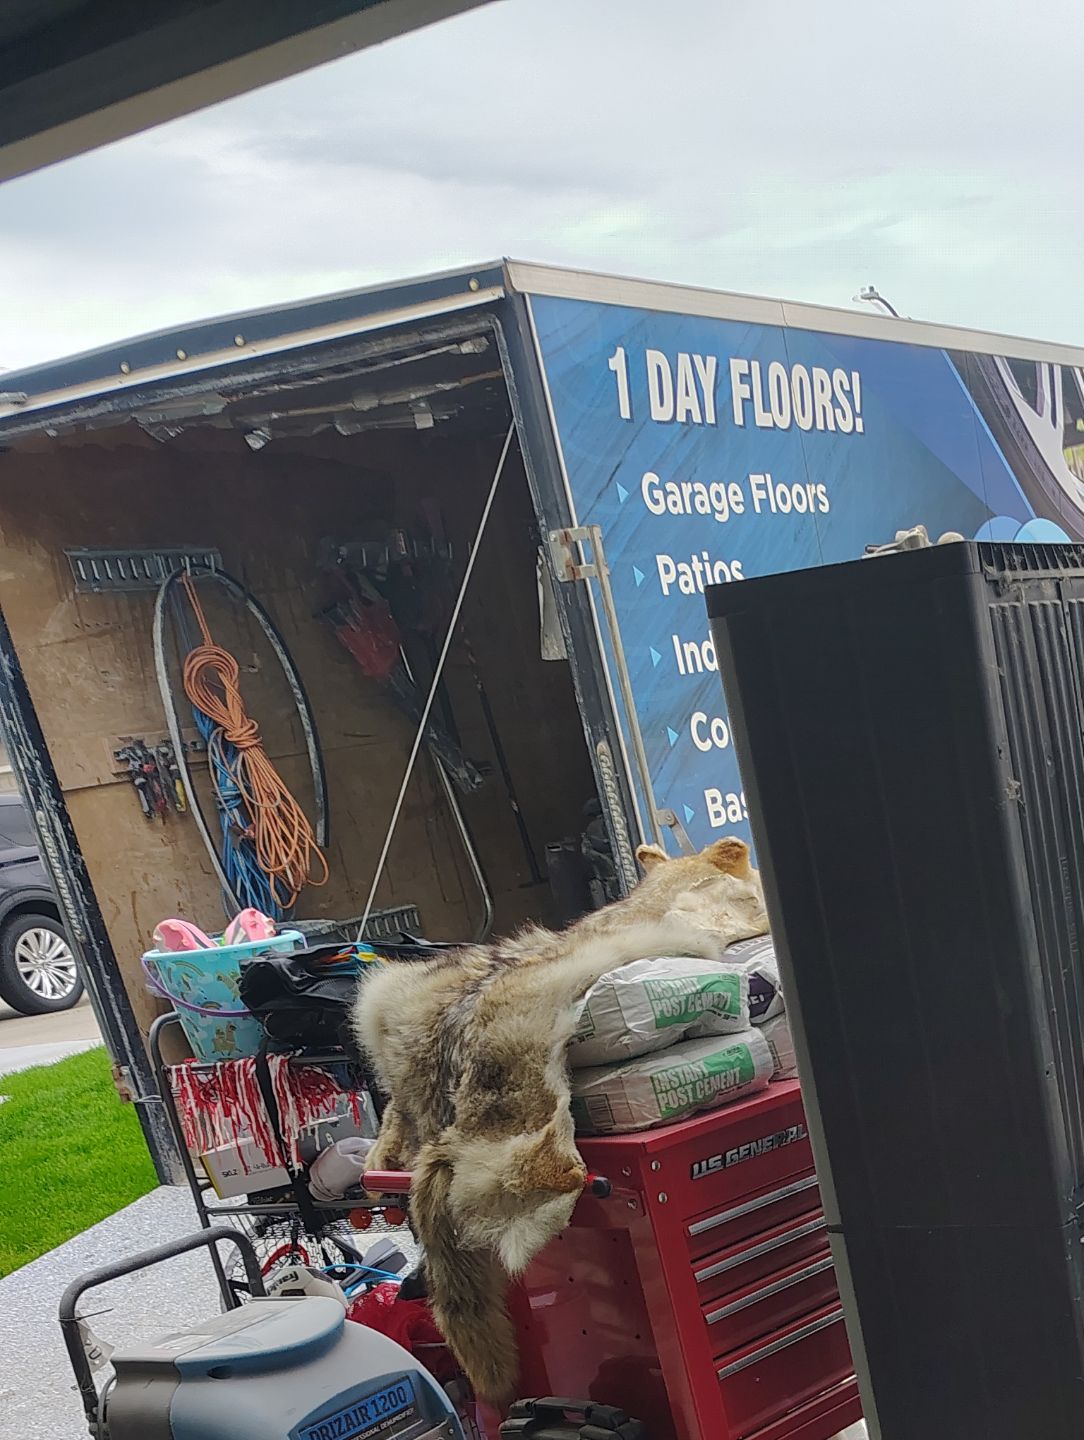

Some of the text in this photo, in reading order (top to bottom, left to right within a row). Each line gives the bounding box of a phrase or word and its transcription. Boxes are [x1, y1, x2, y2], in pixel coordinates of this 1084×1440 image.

[608, 346, 865, 434] 1 DAY FLOORS!
[640, 472, 830, 523] Garage Floors
[656, 552, 745, 596] Patios
[690, 711, 733, 753] Co
[650, 995, 687, 1019] POST
[652, 1060, 709, 1093] INSTANT
[657, 1085, 694, 1112] POST
[696, 1067, 741, 1099] CEMENT
[724, 1123, 808, 1168] GENERAL
[371, 1386, 407, 1417] 1200
